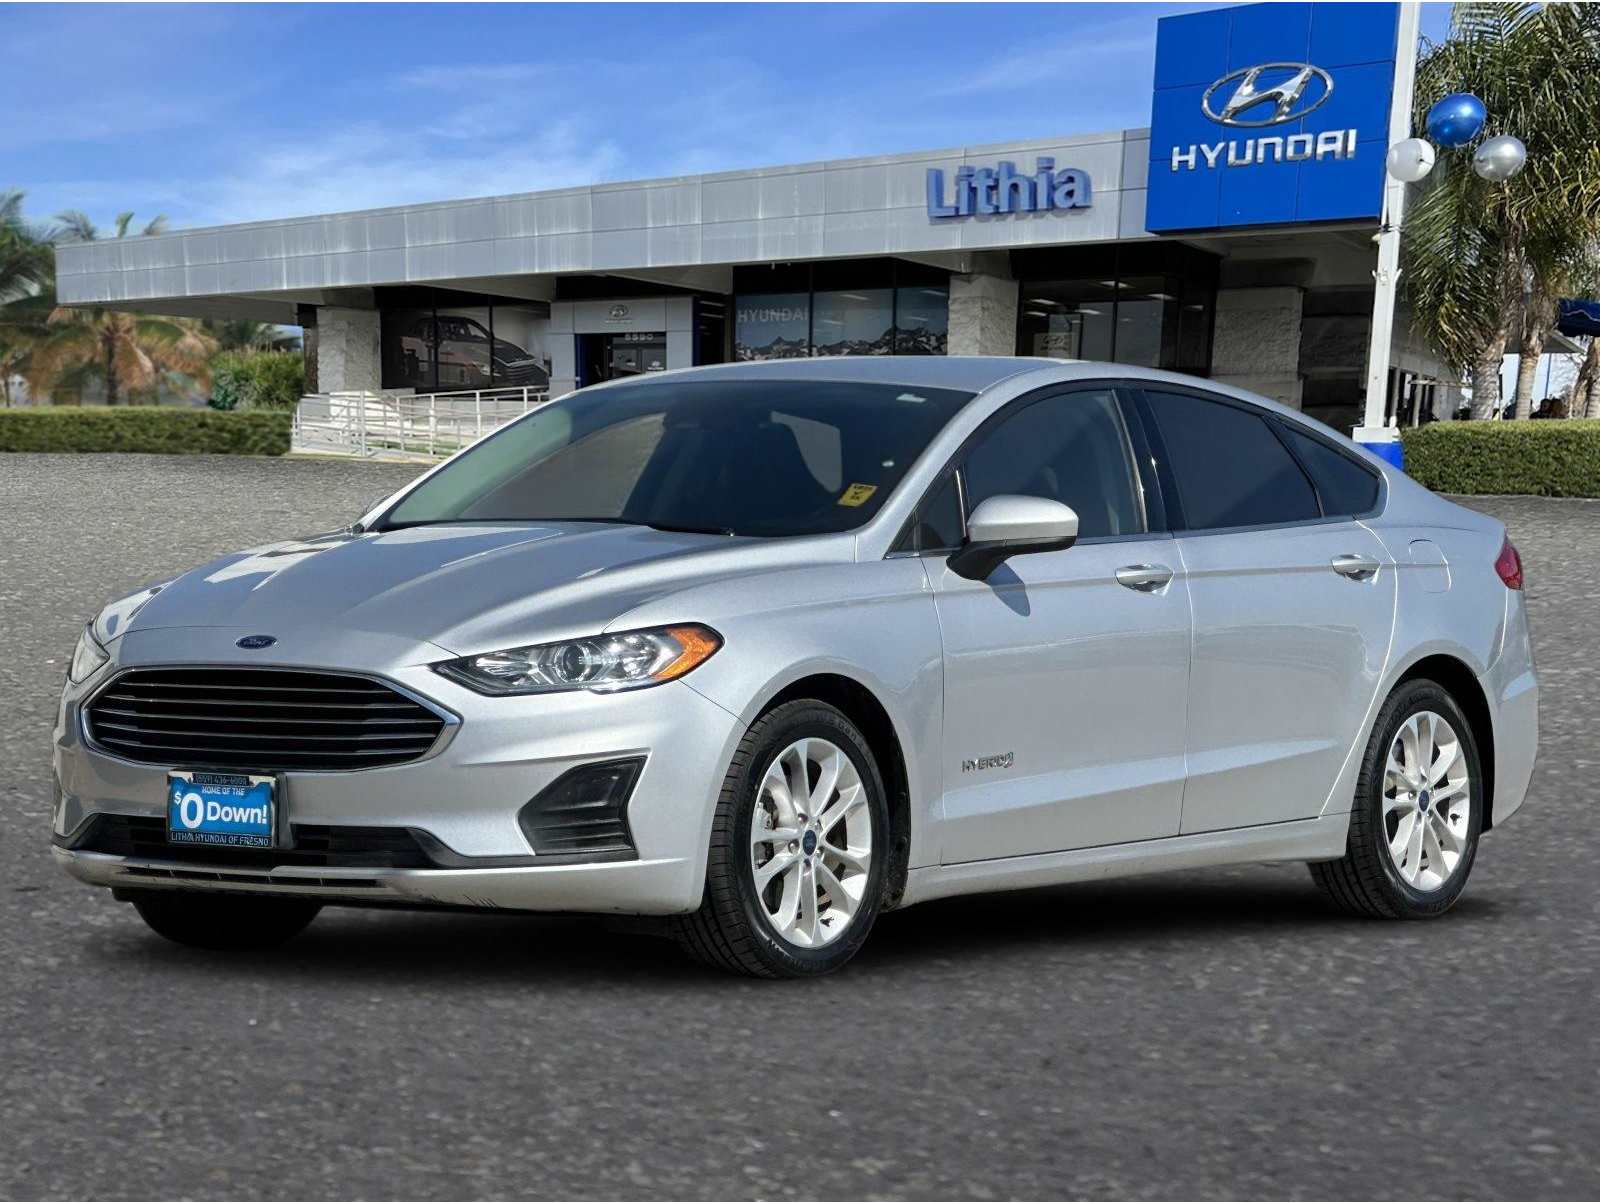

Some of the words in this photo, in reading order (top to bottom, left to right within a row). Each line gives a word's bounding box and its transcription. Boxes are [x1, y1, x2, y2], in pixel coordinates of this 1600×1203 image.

[1170, 129, 1357, 171] HYUNDAI
[926, 156, 1092, 219] Lithia
[737, 307, 808, 323] HYUNDAI
[202, 785, 221, 795] HOME
[222, 787, 231, 795] OF
[232, 787, 245, 796] THE
[206, 801, 267, 825] Down!
[195, 833, 227, 844] HYUNDAI
[228, 836, 238, 845] OF
[239, 836, 269, 847] FRESNO
